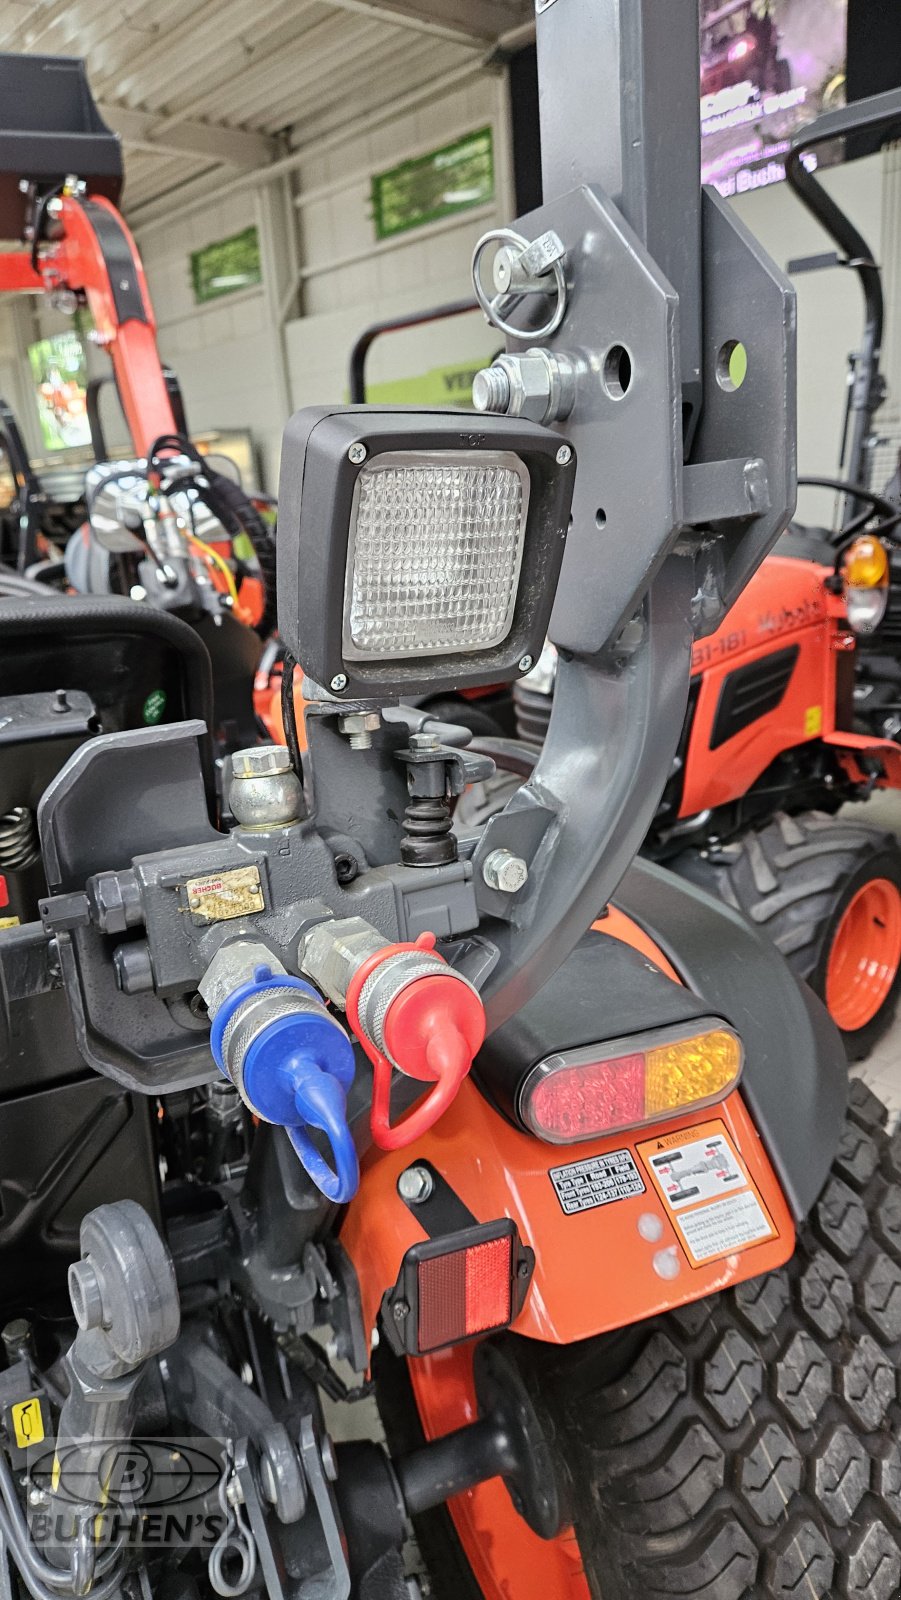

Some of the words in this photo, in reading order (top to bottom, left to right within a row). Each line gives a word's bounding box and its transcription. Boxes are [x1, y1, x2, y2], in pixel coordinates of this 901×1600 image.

[192, 882, 222, 895] BUCHER
[663, 1128, 700, 1146] WARNING
[590, 1169, 607, 1181] Road
[615, 1163, 631, 1174] Field
